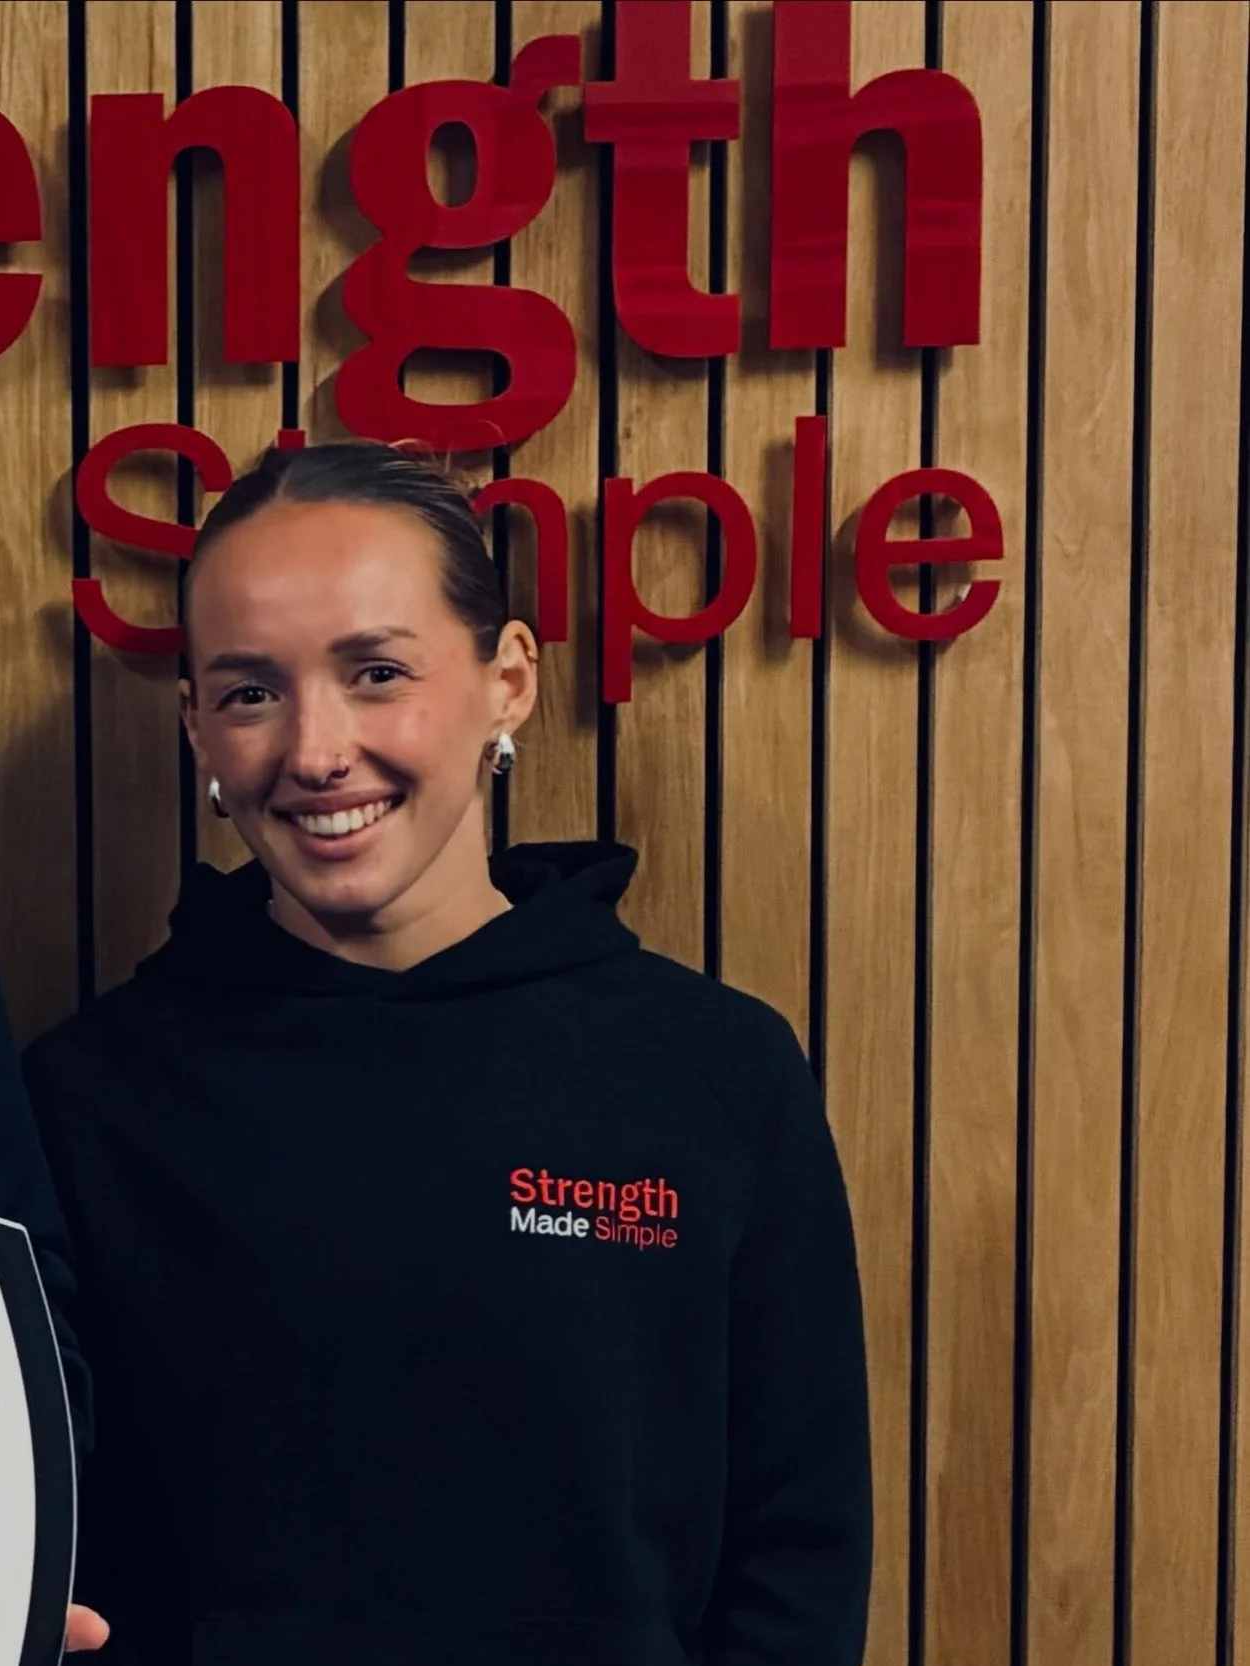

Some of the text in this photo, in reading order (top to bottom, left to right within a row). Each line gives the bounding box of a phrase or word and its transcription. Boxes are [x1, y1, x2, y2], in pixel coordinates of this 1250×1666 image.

[71, 416, 1004, 704] Sple
[510, 1168, 678, 1222] Strength
[510, 1206, 678, 1251] Made Simple
